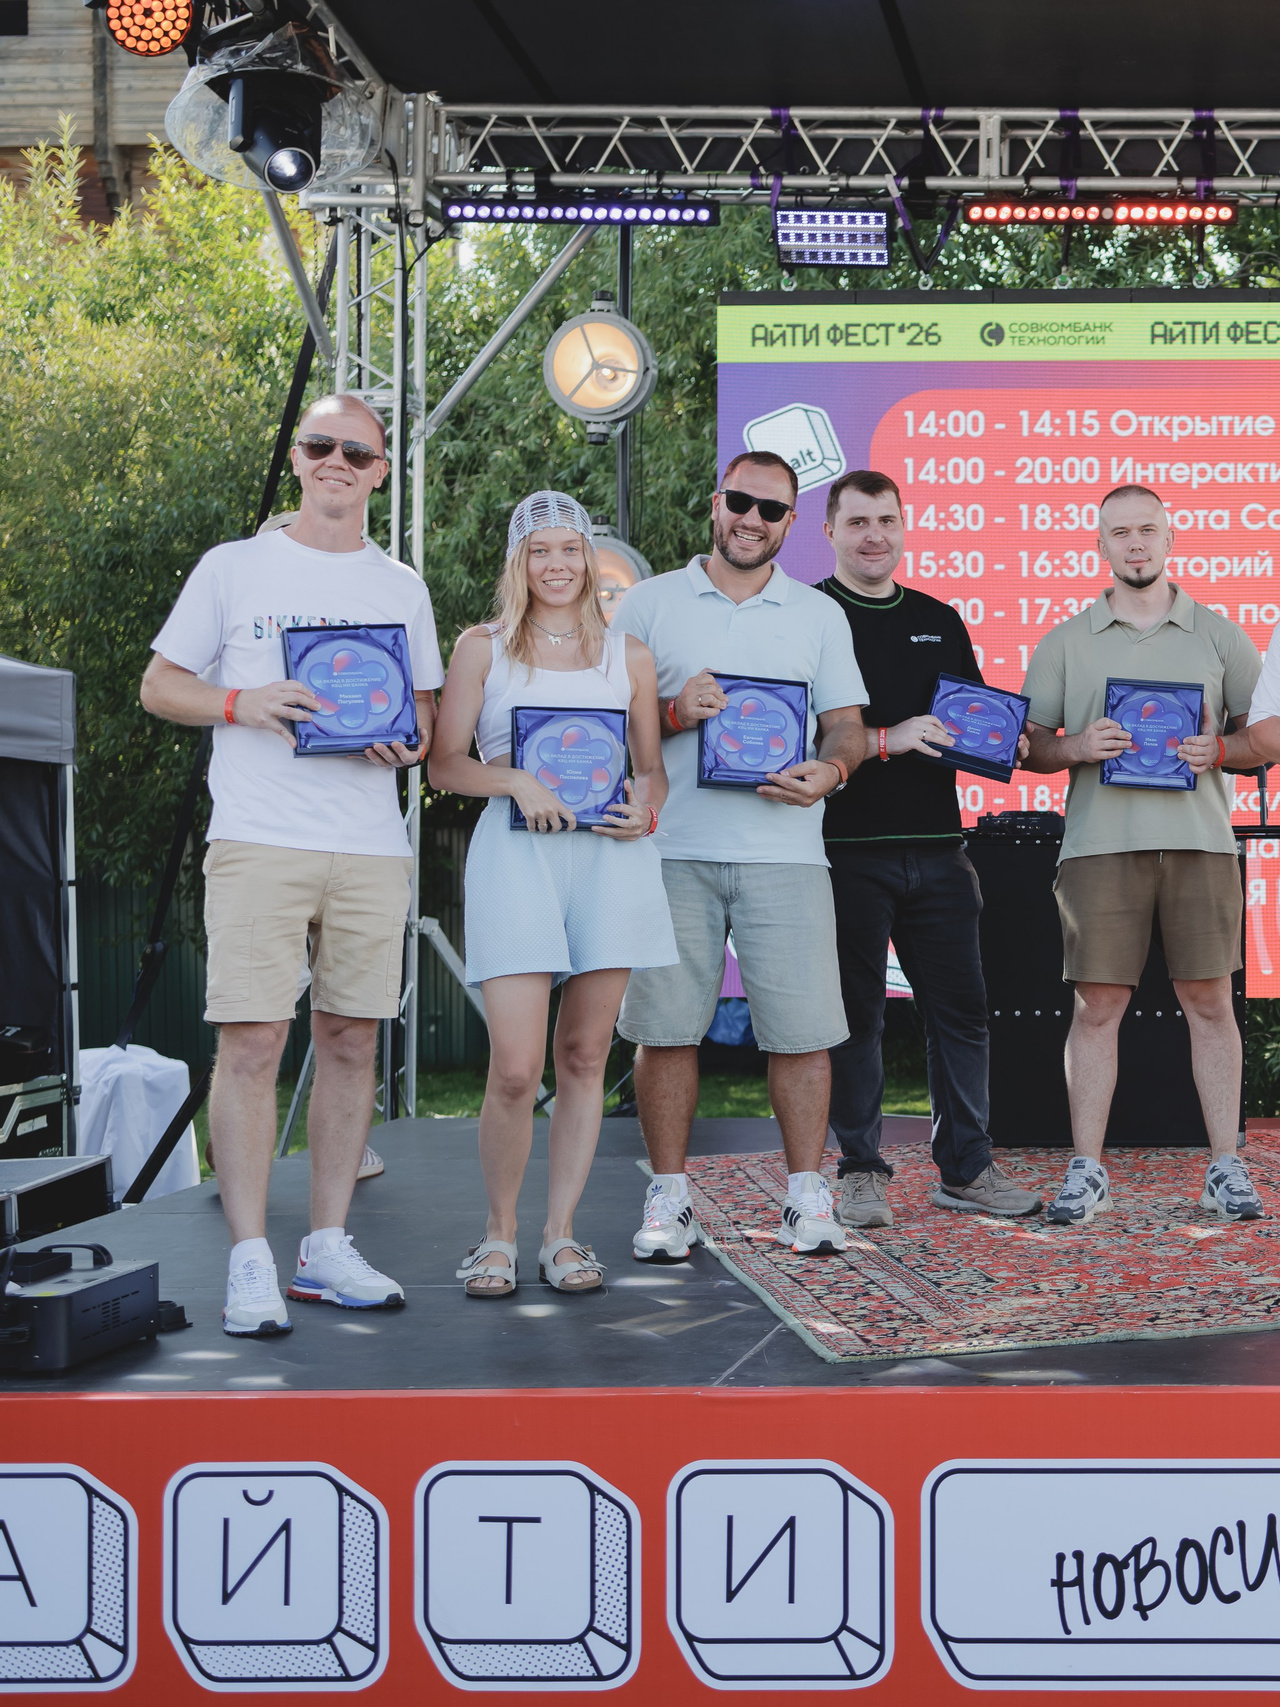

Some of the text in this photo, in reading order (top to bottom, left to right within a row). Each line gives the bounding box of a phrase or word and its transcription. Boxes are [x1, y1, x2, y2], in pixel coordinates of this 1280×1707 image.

[1008, 321, 1114, 334] СОВКОМБАНК
[1009, 334, 1106, 347] ТЕХНОЛОГИИ
[903, 409, 986, 438] 14:00
[1018, 409, 1101, 438] 14:15
[1109, 408, 1276, 443] Открытие
[790, 450, 816, 470] alt
[903, 457, 985, 485] 14:00
[1014, 456, 1100, 484] 20:00
[903, 503, 985, 532] 14:30
[1018, 503, 1100, 531] 18:30
[1163, 502, 1230, 531] бота
[903, 550, 985, 579] 15:30
[1018, 550, 1100, 578] 16:30
[1017, 784, 1068, 812] 18:
